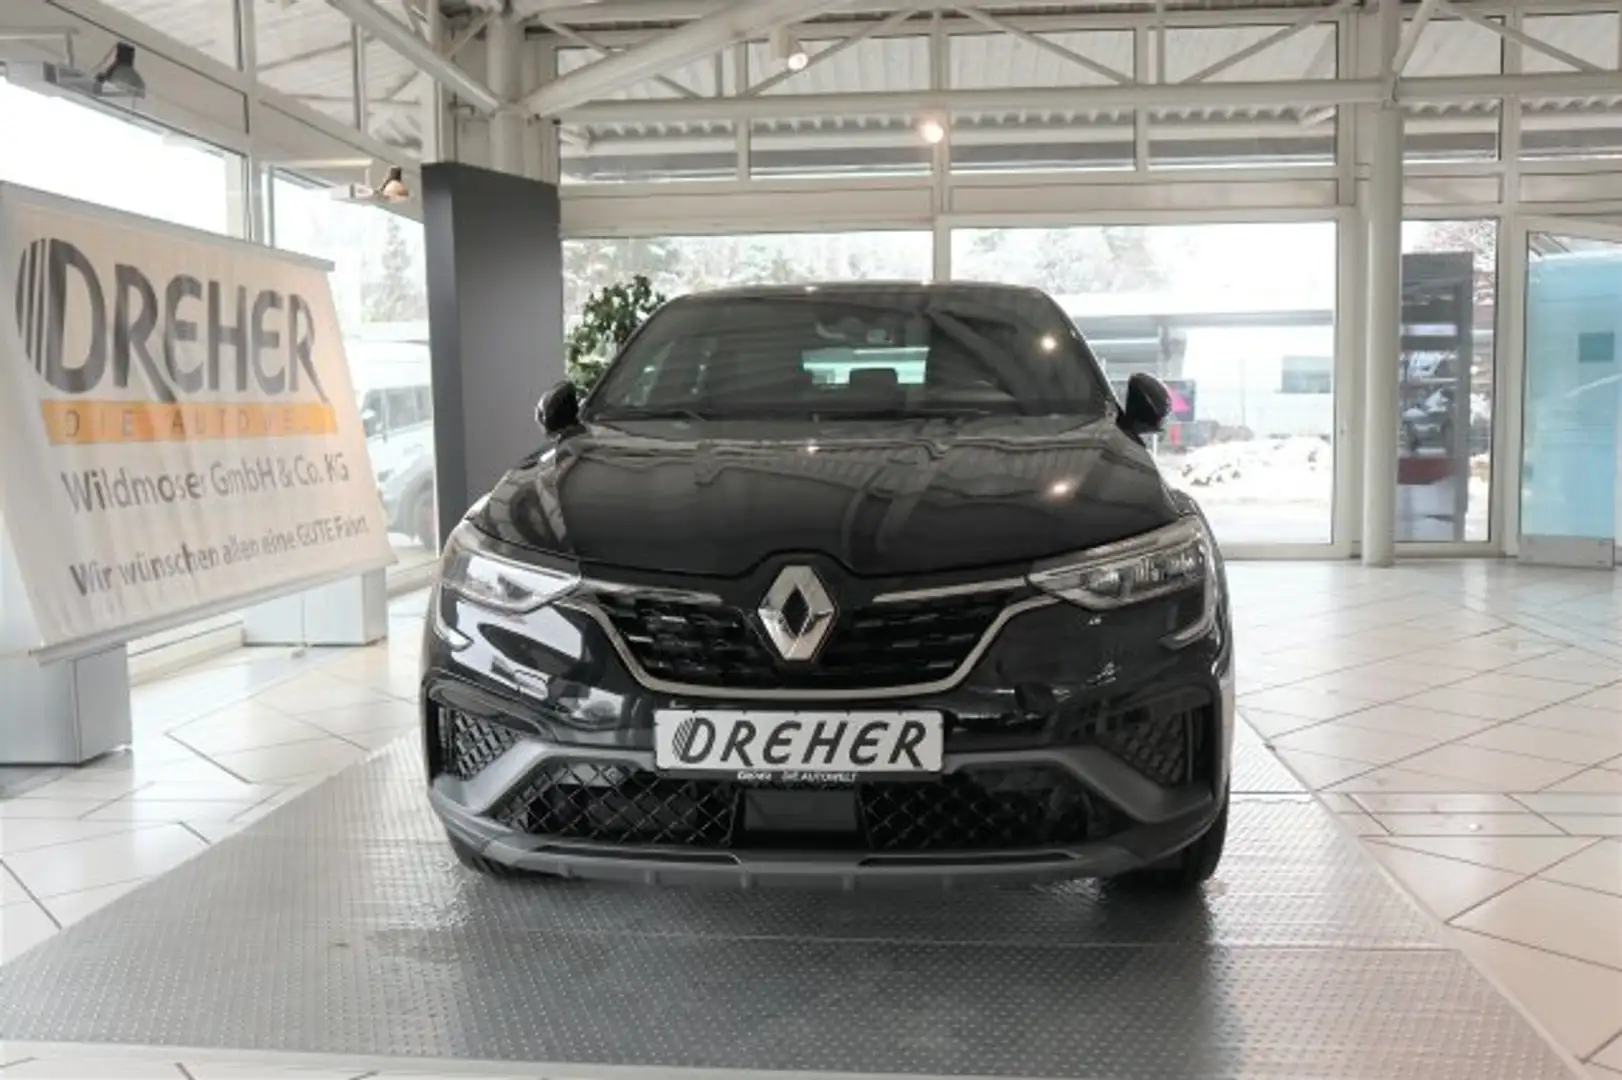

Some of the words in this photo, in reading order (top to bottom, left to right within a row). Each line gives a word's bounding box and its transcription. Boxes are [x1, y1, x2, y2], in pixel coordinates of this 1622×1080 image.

[15, 238, 327, 403] DREHER
[210, 455, 279, 498] GmbH
[278, 457, 294, 488] &
[294, 454, 322, 484] Co.
[324, 451, 350, 481] KG
[69, 561, 112, 597] Wir
[119, 541, 220, 586] wünschen
[261, 527, 296, 554] eine
[296, 518, 333, 546] GUTE
[672, 716, 927, 768] DREHER
